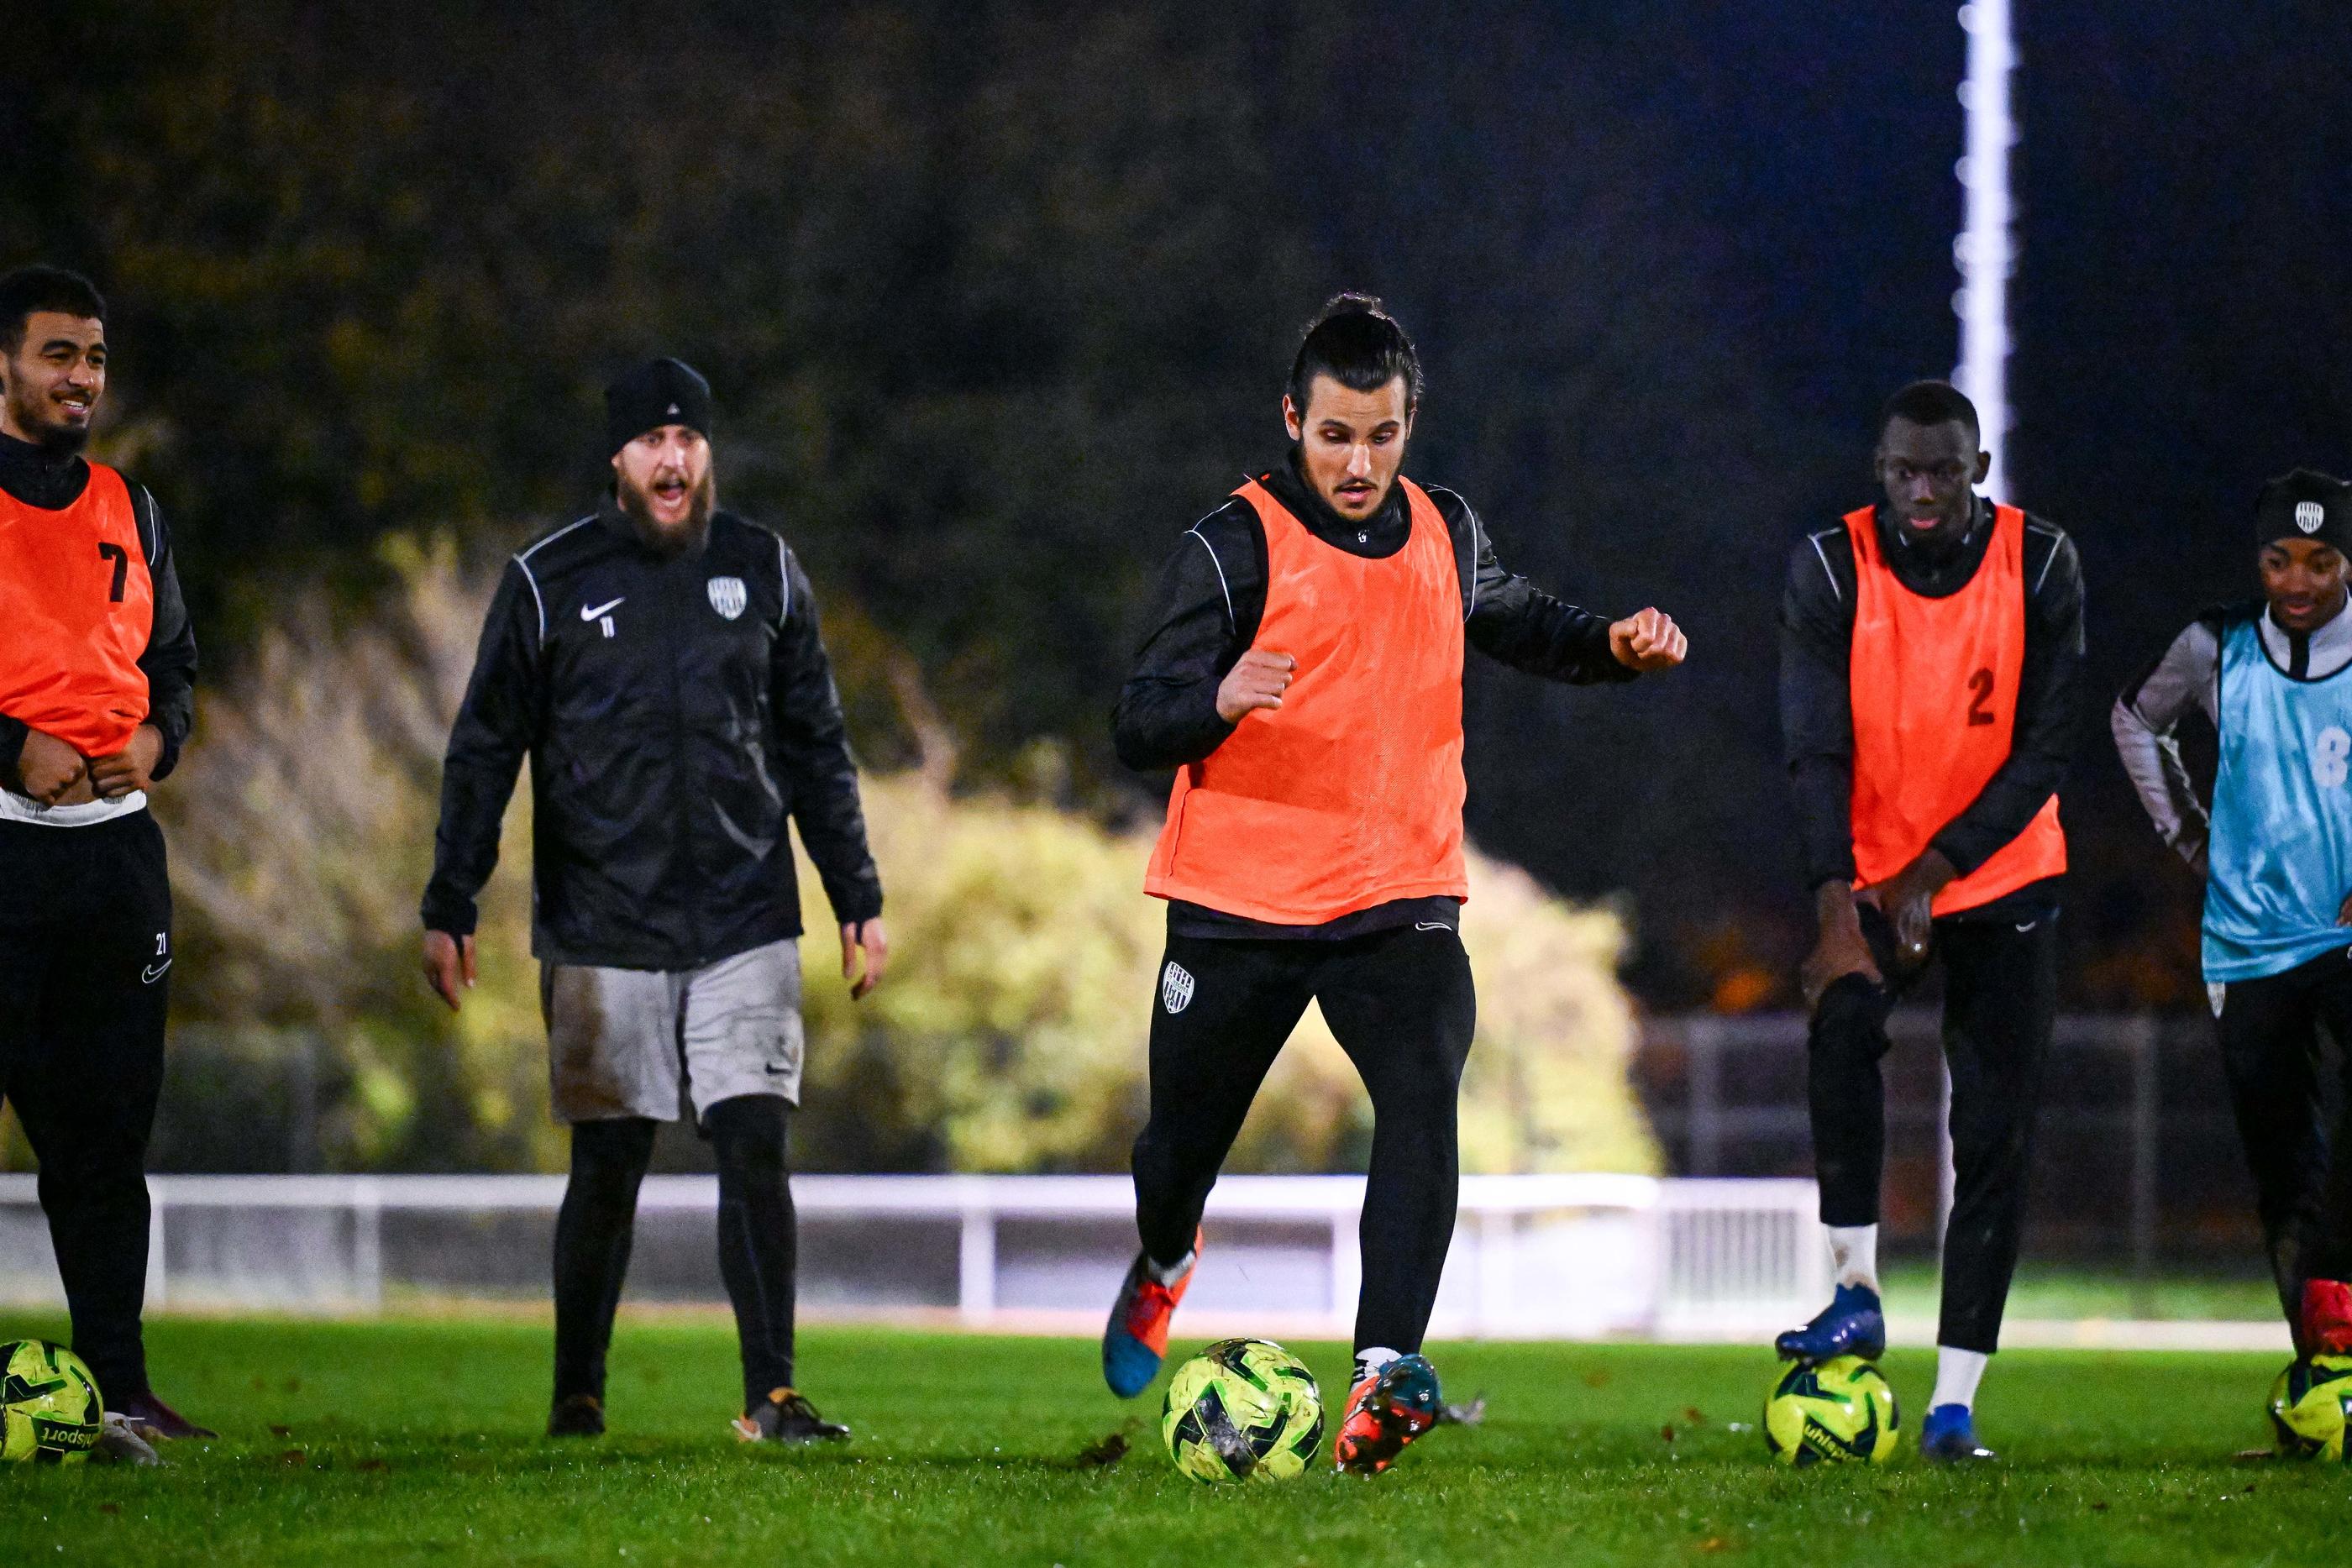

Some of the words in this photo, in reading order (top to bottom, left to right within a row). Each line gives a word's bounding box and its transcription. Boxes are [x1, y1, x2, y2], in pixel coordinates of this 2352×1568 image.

[97, 542, 128, 603] 7
[1967, 667, 1995, 726] 2
[2312, 726, 2351, 788] 8
[155, 931, 166, 956] 21
